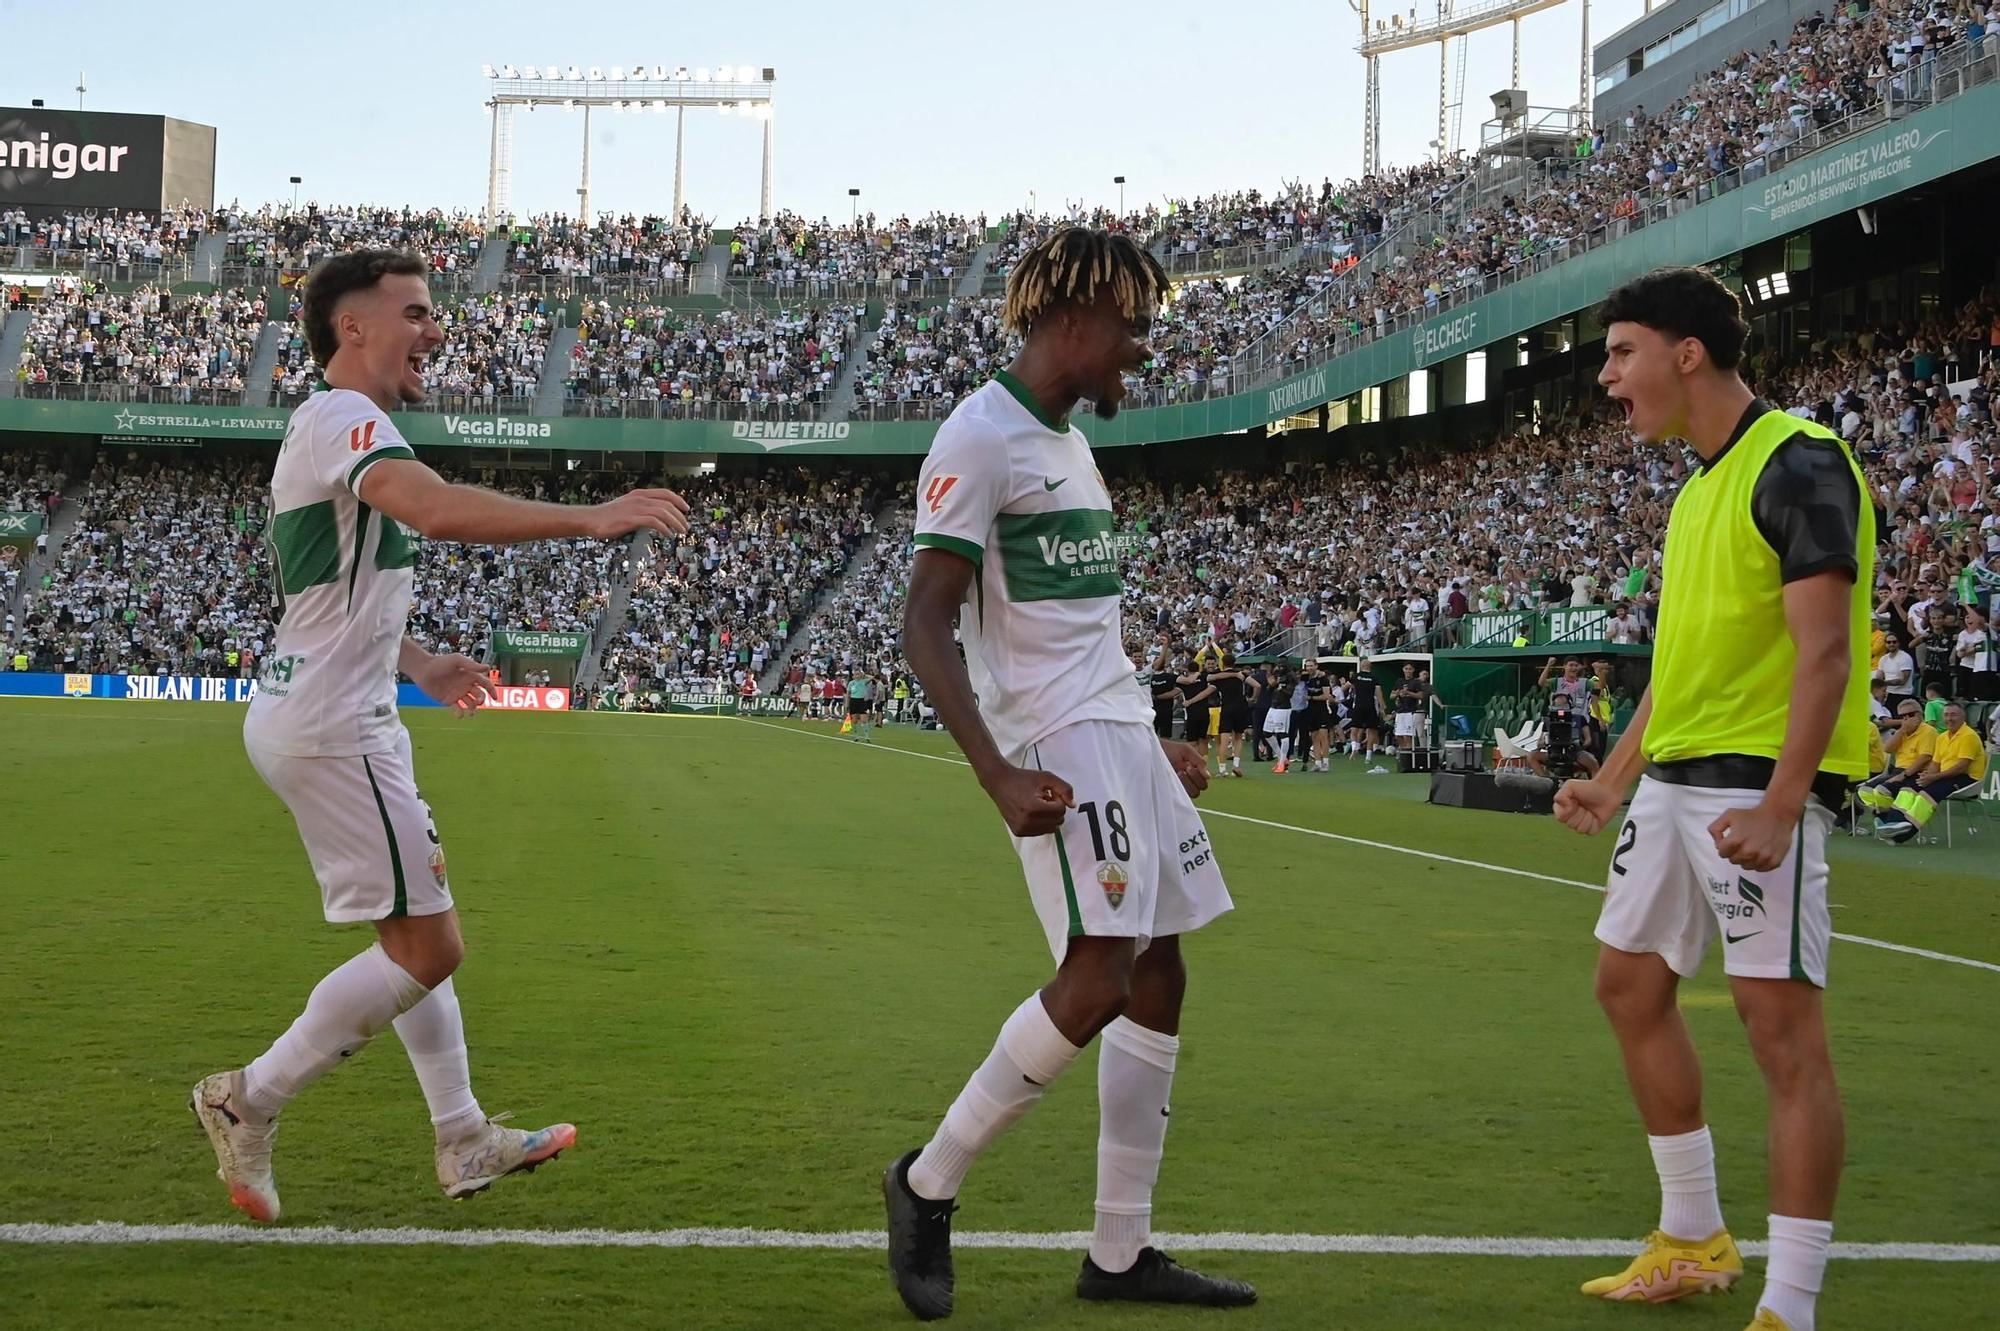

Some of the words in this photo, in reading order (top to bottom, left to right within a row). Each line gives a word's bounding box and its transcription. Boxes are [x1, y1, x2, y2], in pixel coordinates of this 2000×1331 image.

[1764, 174, 1808, 206] ESTADIO
[1810, 149, 1868, 187] MARTÍNEZ
[1871, 128, 1920, 163] VALERO
[1268, 368, 1327, 414] INFORMACIÓN
[138, 415, 210, 428] ESTRELLA
[221, 418, 285, 430] LEVANTE
[732, 421, 850, 439] DEMETRIO
[1070, 567, 1082, 577] EL
[1084, 565, 1099, 576] REY
[1101, 564, 1109, 573] DE
[126, 675, 194, 701] SOLAN
[200, 677, 227, 701] DE
[671, 693, 734, 705] DEMETRIO
[1078, 800, 1131, 862] 18
[1179, 829, 1207, 854] ext
